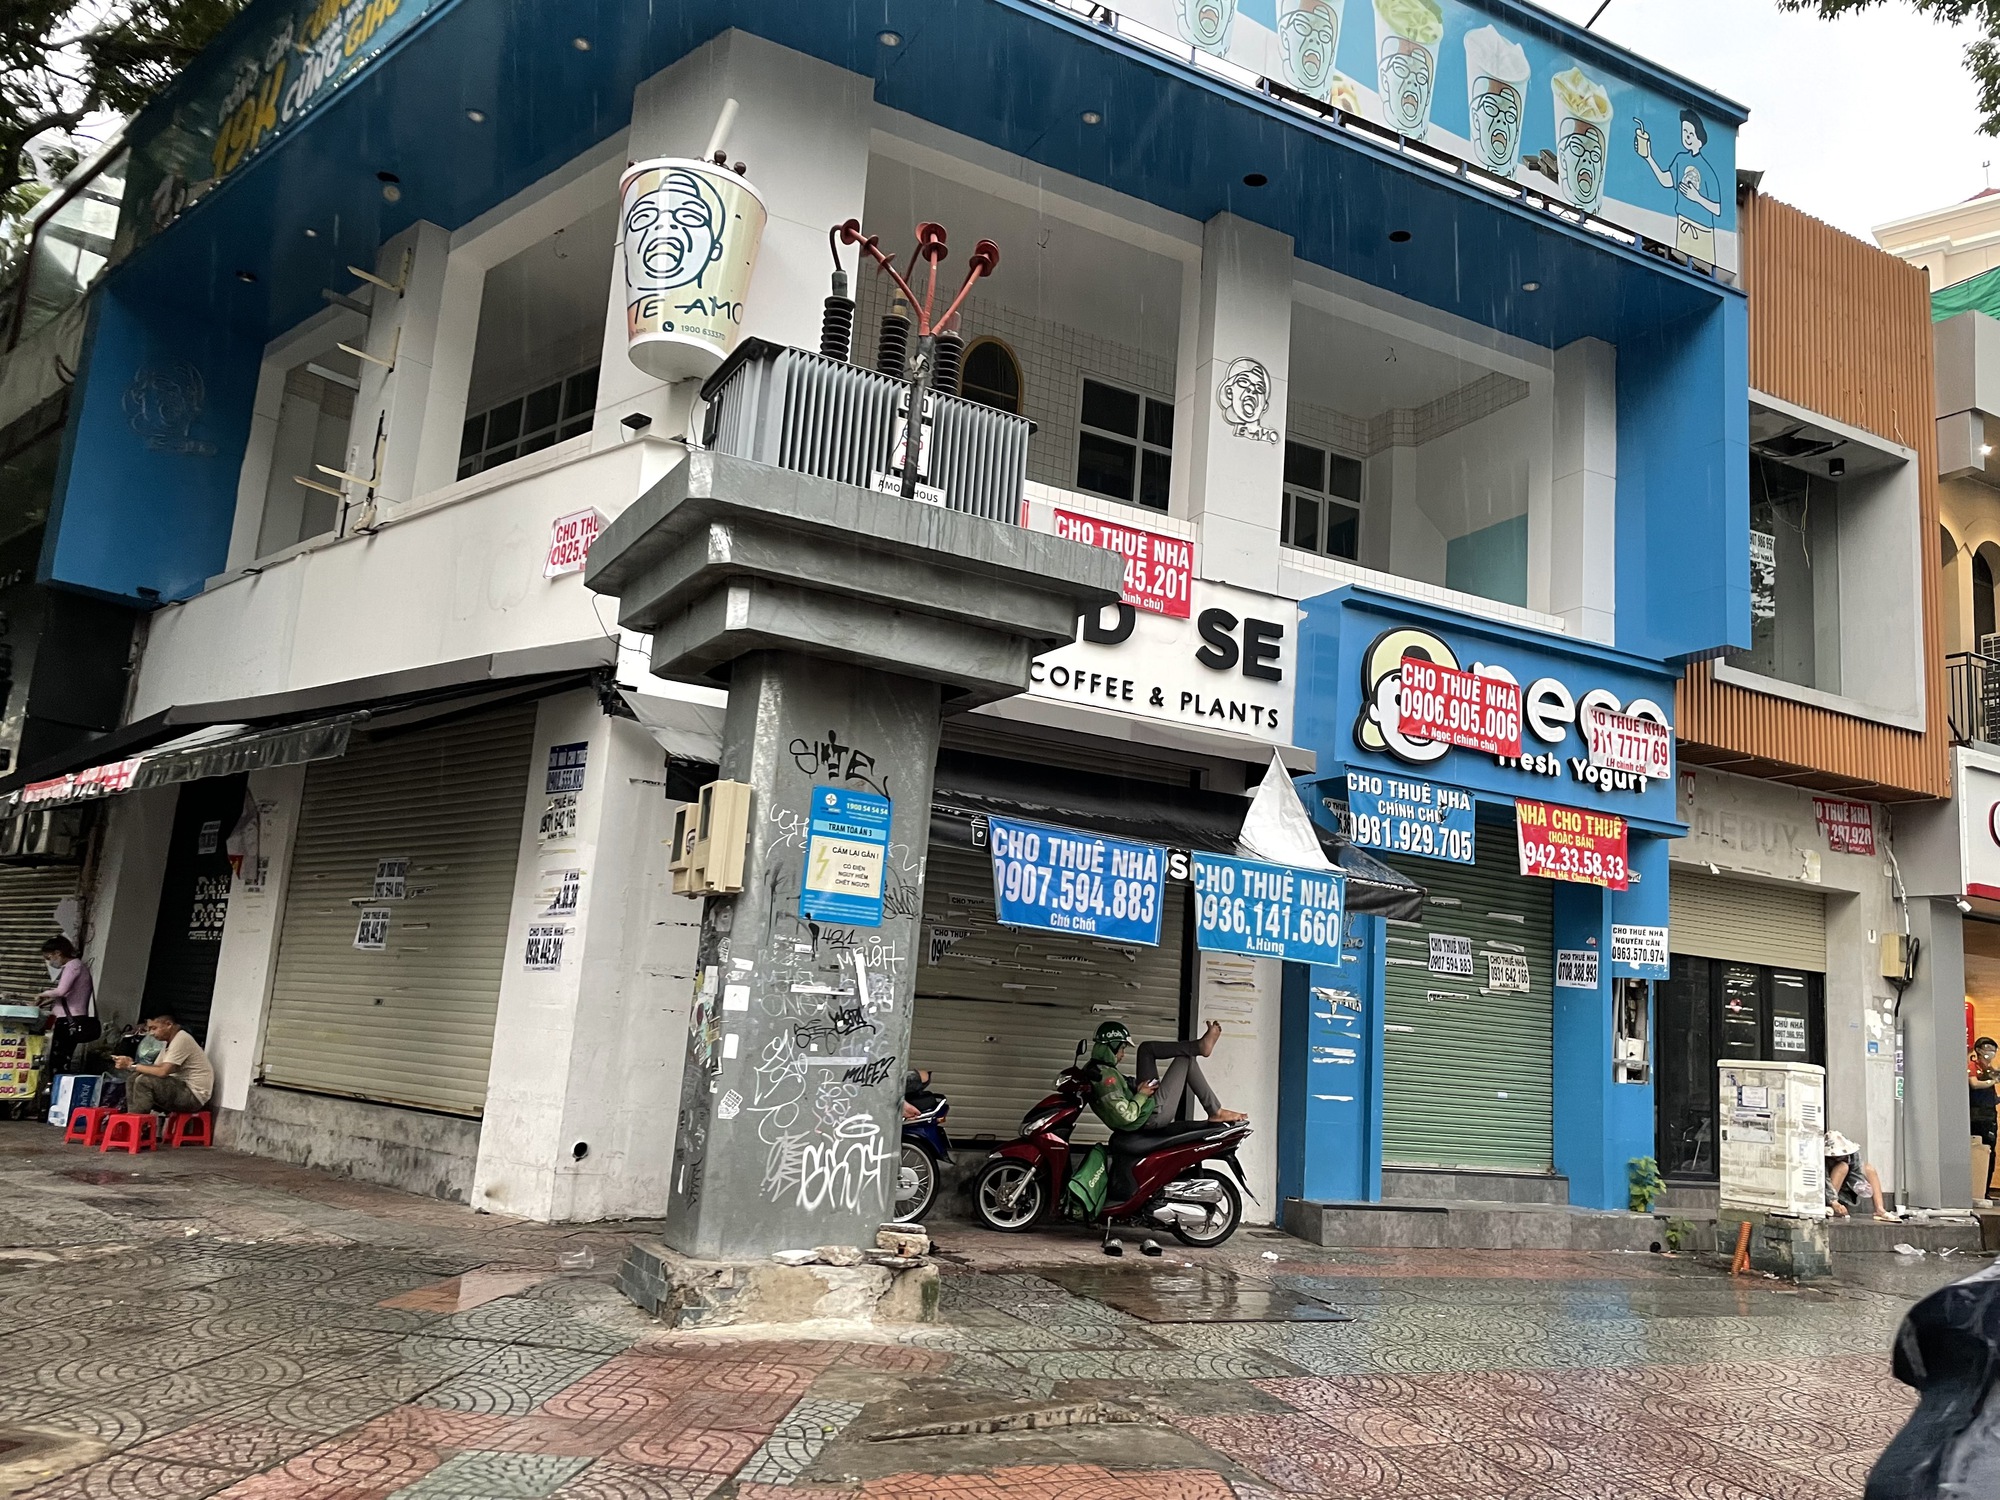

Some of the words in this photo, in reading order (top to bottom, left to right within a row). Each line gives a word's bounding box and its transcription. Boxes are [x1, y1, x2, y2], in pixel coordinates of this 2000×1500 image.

[556, 521, 577, 543] CHO
[1056, 515, 1094, 545] CHO
[1101, 530, 1148, 559] THUÊ
[1154, 539, 1190, 570] NHÀ
[1030, 661, 1135, 702] COFFEE
[1149, 687, 1165, 707] &
[1180, 691, 1279, 729] PLANTS
[1402, 663, 1436, 691] CHO
[1441, 675, 1481, 703] THUÊ
[1486, 683, 1518, 712] NHÀ
[1400, 687, 1518, 742] 0906.905.006
[1420, 724, 1429, 735] A.
[1431, 726, 1452, 741] Ngọc
[1453, 734, 1479, 747] (chính
[1480, 740, 1498, 754] chủ)
[1617, 733, 1649, 762] 7777
[1652, 740, 1668, 766] 69
[1606, 756, 1616, 768] LH
[1347, 772, 1383, 796] CHO
[1387, 781, 1432, 804] THUÊ
[1437, 789, 1471, 811] NHÀ
[1378, 800, 1415, 820] CHÍNH
[1517, 802, 1547, 827] NHÀ
[1552, 809, 1581, 833] CHO
[1585, 816, 1622, 839] THUÊ
[1824, 802, 1849, 822] THUÊ
[829, 823, 846, 834] TRẠM
[868, 829, 873, 837] 3
[1349, 811, 1473, 861] 0981.929.705
[992, 827, 1040, 863] CHO
[1048, 837, 1106, 874] THUÊ
[1111, 848, 1158, 883] NHÀ
[994, 858, 1156, 924] 0907.594.883
[1195, 862, 1235, 895] CHO
[1242, 869, 1294, 904] THUÊ
[1300, 878, 1340, 911] NHÀ
[934, 928, 949, 937] CHO
[1073, 916, 1096, 931] Chốt
[1196, 892, 1340, 948] 0936.141.660
[1613, 927, 1628, 935] CHO
[1629, 928, 1646, 937] THUÊ
[1648, 929, 1664, 937] NHÀ
[1246, 936, 1285, 957] A.Hùng
[1430, 937, 1442, 952] CHO
[1611, 946, 1665, 963] 0963.570.974
[1490, 955, 1501, 965] CHO
[1505, 967, 1517, 982] 642
